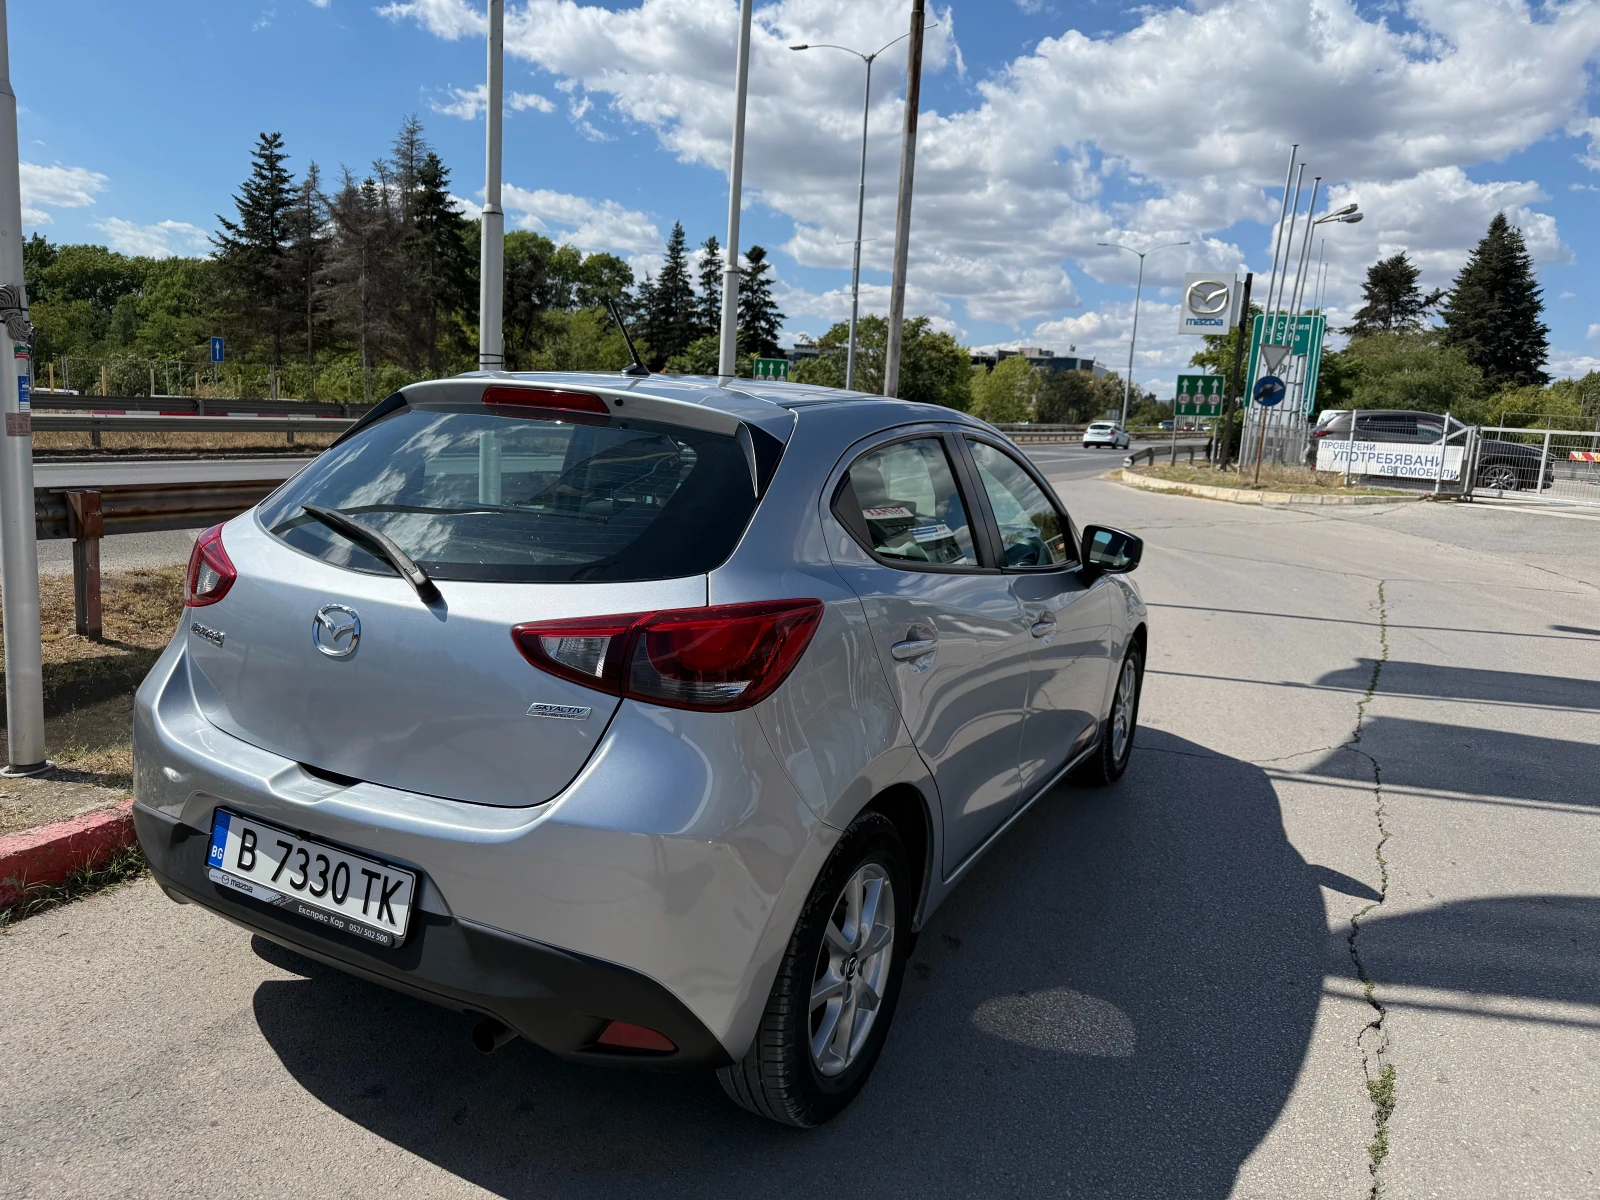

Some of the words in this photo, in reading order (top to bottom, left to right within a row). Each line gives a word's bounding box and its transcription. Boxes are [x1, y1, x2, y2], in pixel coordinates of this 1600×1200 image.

[1186, 318, 1223, 326] mazda
[1321, 441, 1376, 451] ПРОВЕРЕНИ
[534, 704, 584, 713] SKYACTIV
[211, 845, 224, 860] BG
[237, 827, 257, 871] B
[271, 839, 350, 905] 7330
[361, 867, 404, 925] TK
[230, 879, 254, 893] mazda
[298, 905, 328, 923] Експрес
[330, 915, 344, 929] Кар
[349, 923, 363, 935] 052/
[364, 929, 375, 939] 502
[375, 932, 388, 943] 500
